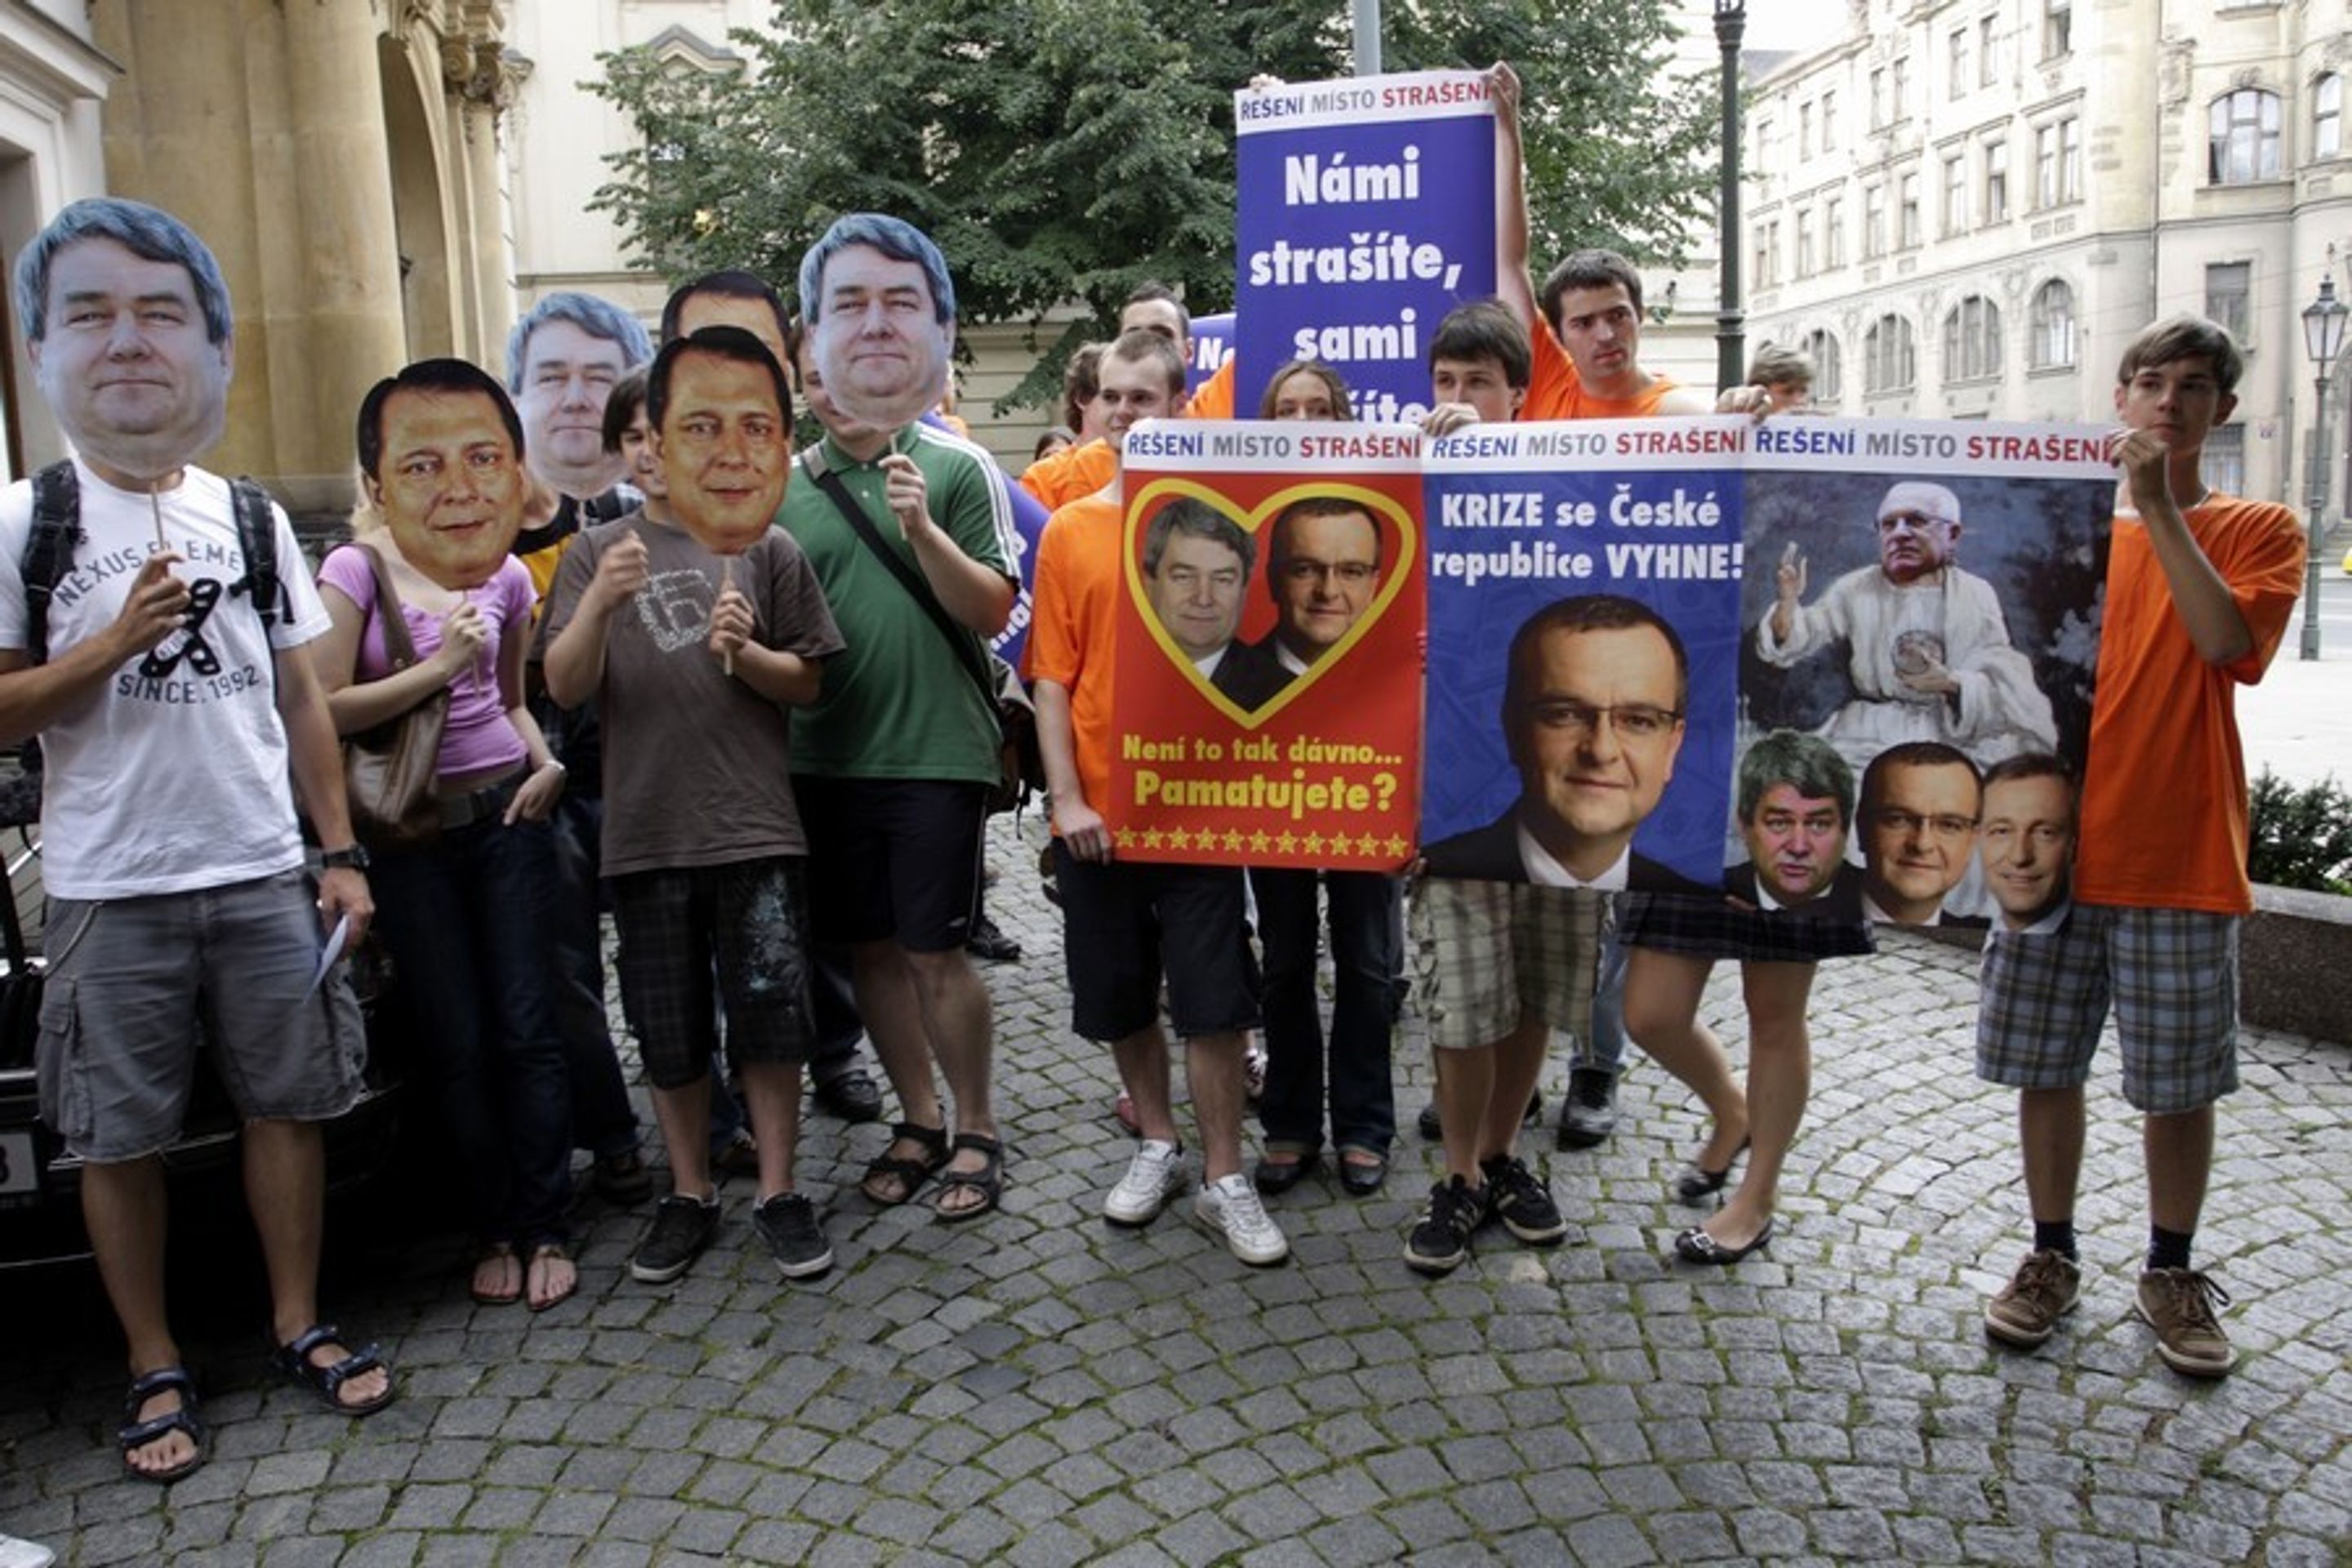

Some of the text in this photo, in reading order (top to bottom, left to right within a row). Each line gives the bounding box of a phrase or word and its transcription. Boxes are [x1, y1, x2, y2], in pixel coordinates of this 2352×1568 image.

[1312, 88, 1375, 113] MÍSTO
[1285, 145, 1420, 206] Námi
[1249, 231, 1463, 290] strašíte,
[1293, 307, 1417, 362] sami
[1213, 430, 1291, 458] MÍSTO
[1298, 430, 1421, 459] STRAŠENÍ
[1526, 431, 1606, 456] MÍSTO
[1615, 425, 1746, 454] STRAŠENÍ
[1755, 425, 1855, 455] ŘEŠENÍ
[1866, 428, 1957, 458] MÍSTO
[1441, 483, 1721, 527] KRIZE se České
[55, 546, 143, 608] NEXUS
[1432, 541, 1744, 586] republice VYHNE!
[1123, 733, 1403, 765] Není to tak dávno...
[1134, 768, 1397, 820] Pamatujete?
